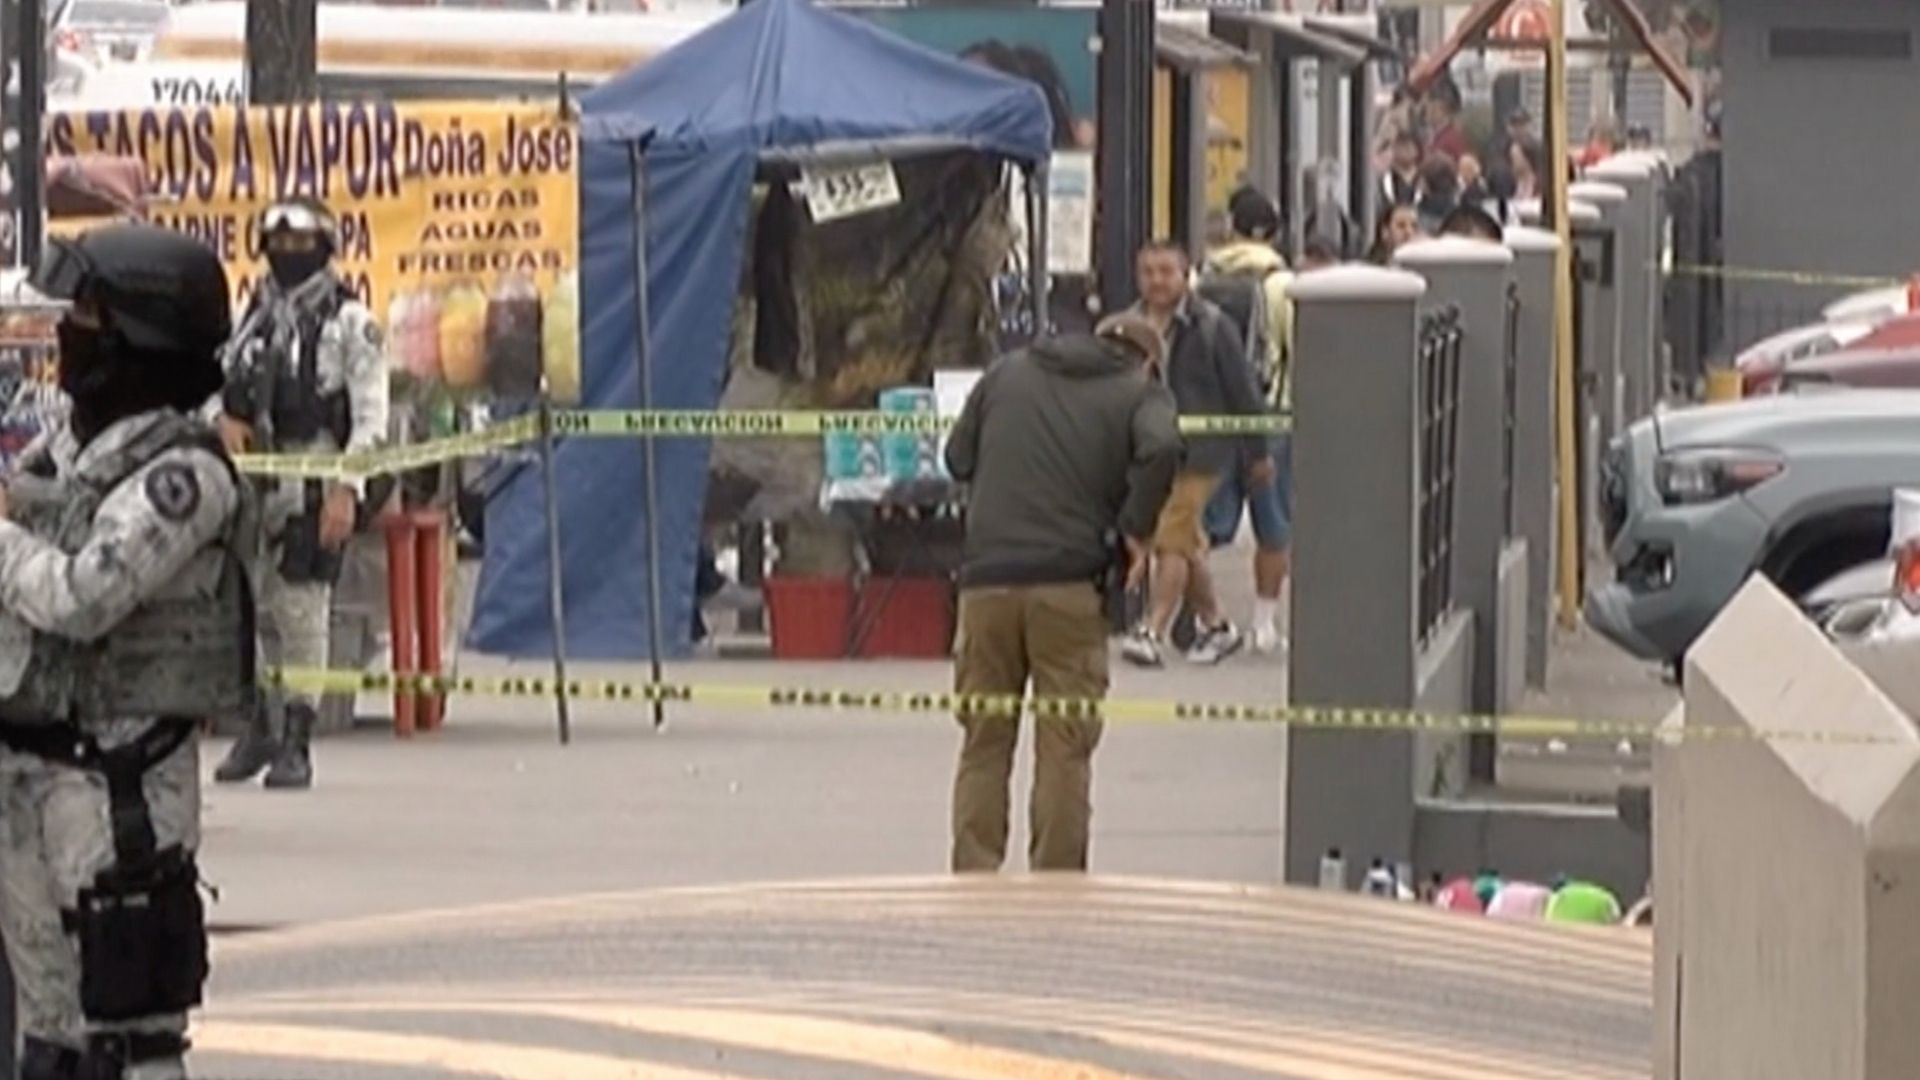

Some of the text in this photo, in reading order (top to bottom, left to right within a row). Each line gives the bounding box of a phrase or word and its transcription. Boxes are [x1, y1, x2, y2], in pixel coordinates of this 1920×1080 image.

[230, 101, 255, 201] A
[267, 98, 399, 204] VAPOR
[403, 117, 485, 177] Doña
[433, 187, 539, 211] RICAS
[421, 220, 541, 242] AGUAS
[398, 250, 561, 273] FRESCAS
